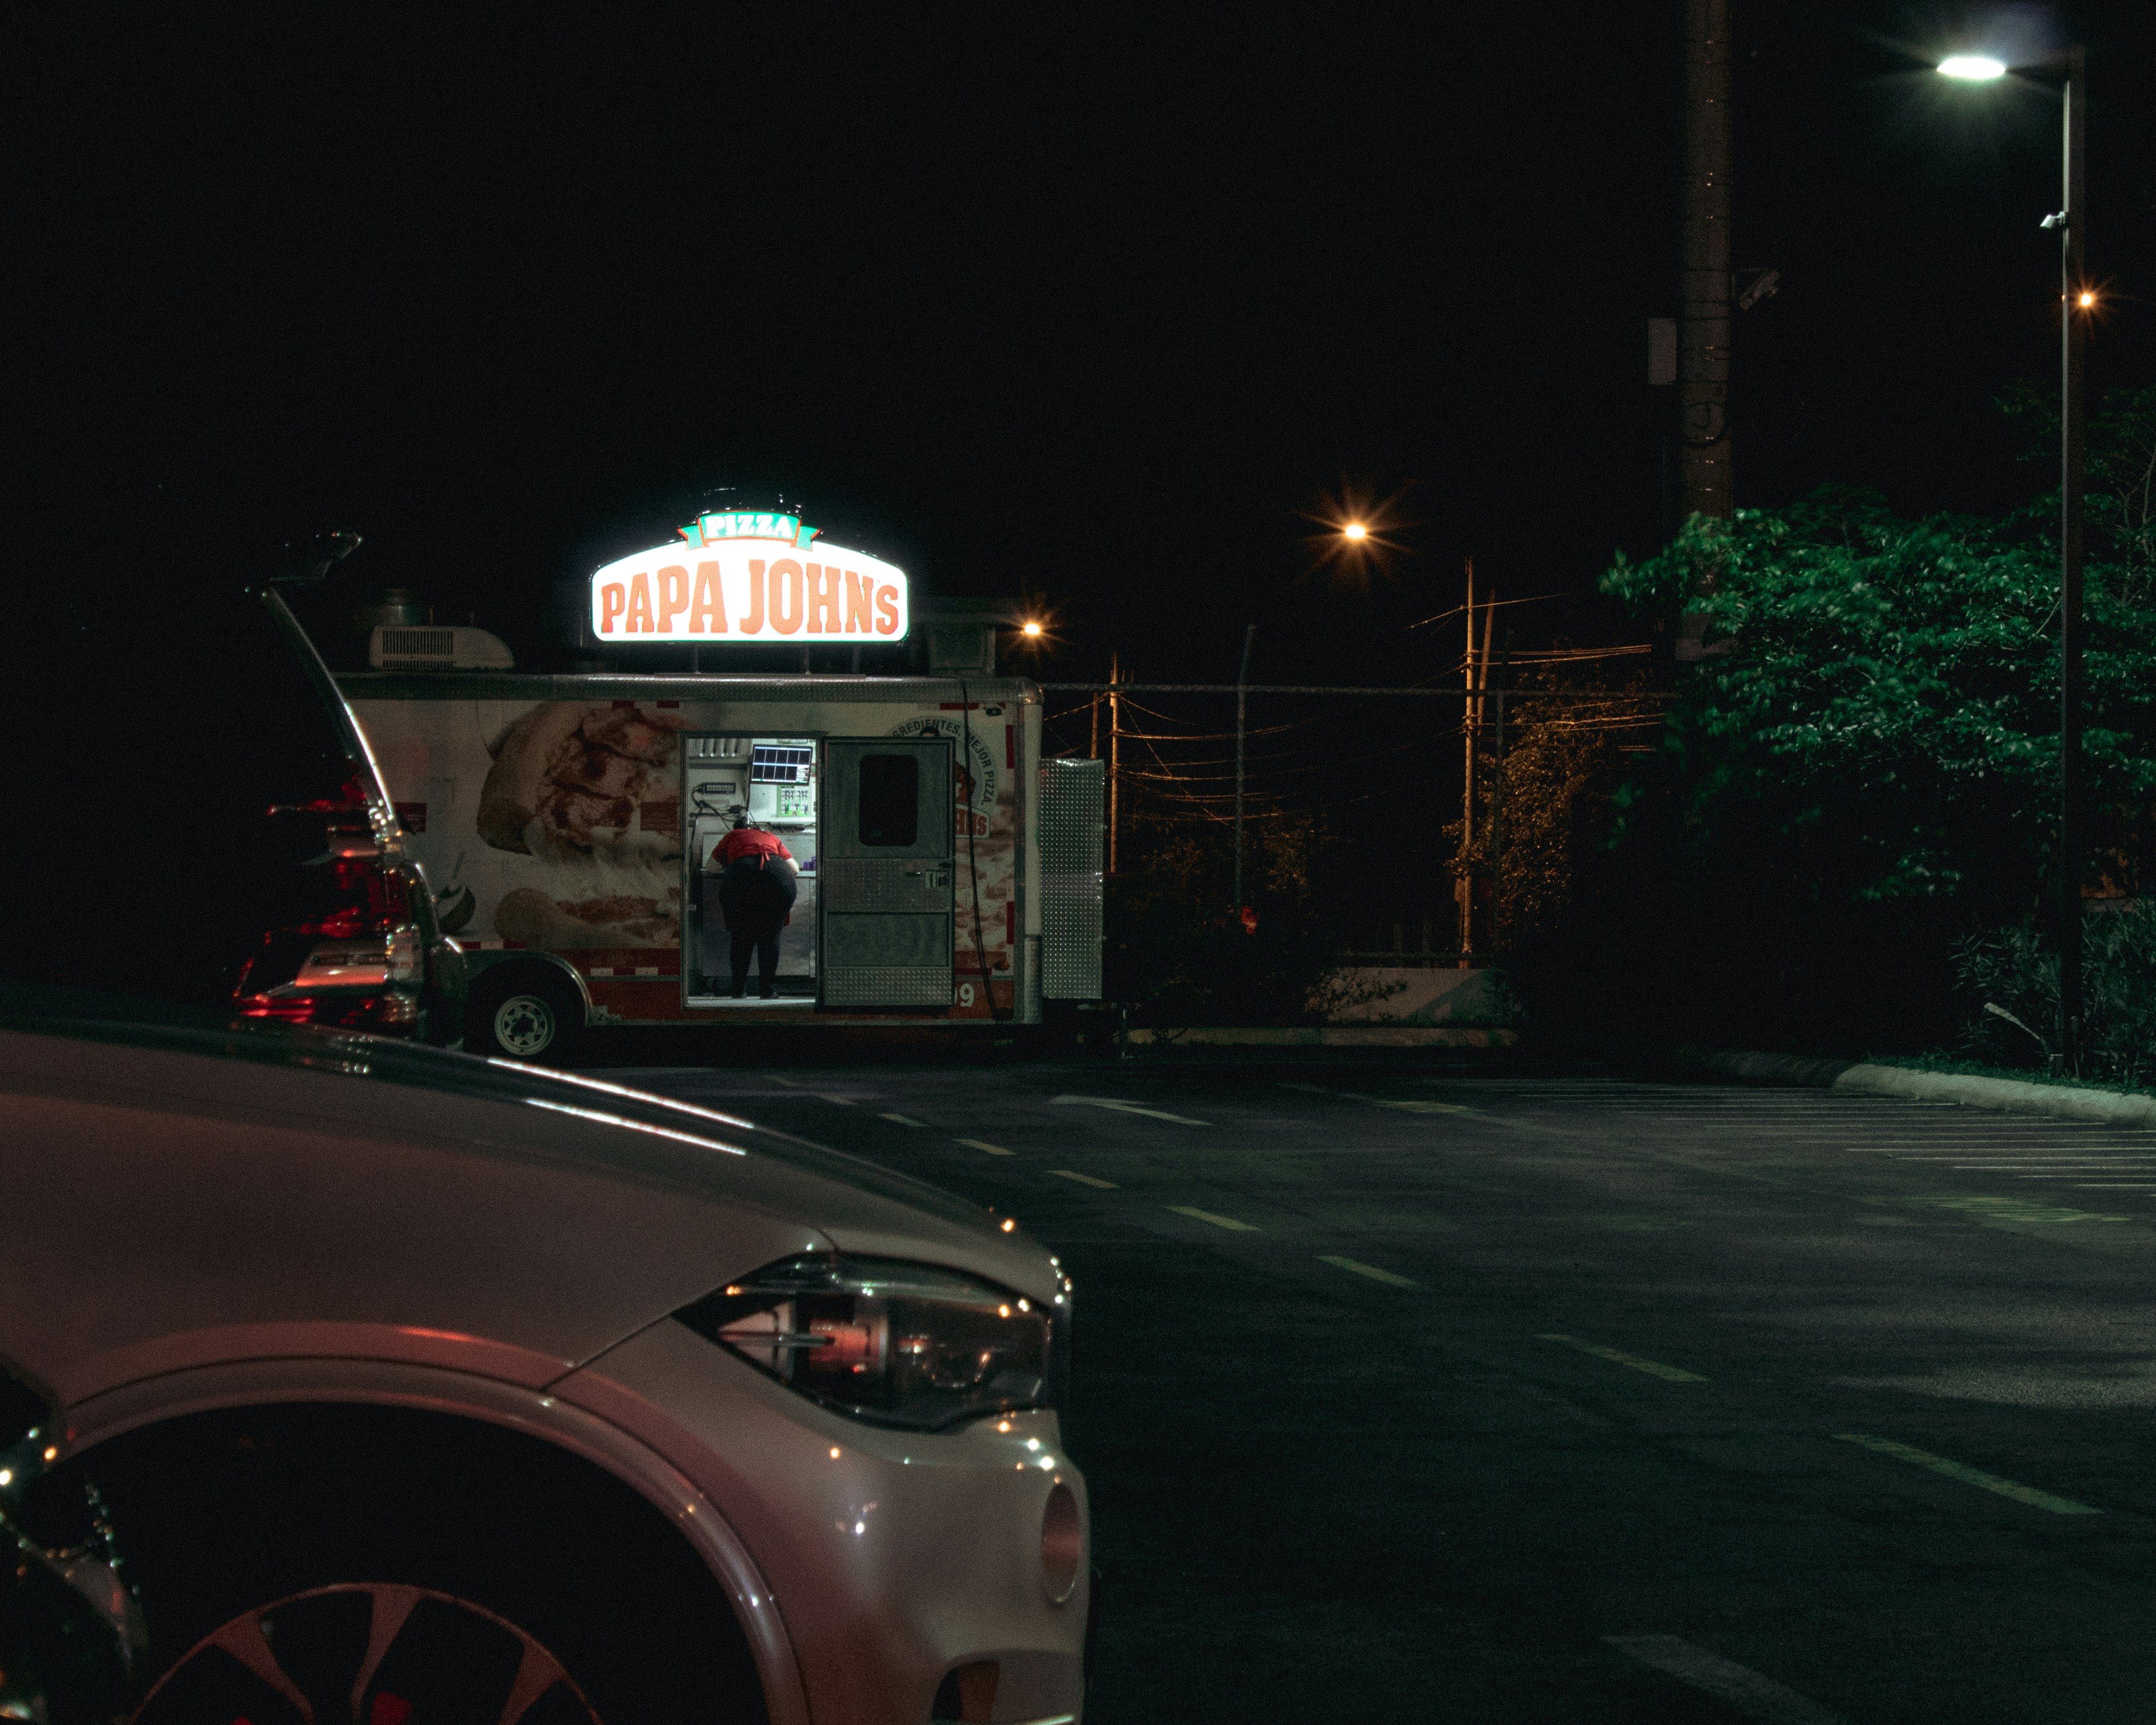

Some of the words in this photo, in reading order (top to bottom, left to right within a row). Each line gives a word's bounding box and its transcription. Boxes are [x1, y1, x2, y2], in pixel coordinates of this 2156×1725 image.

[705, 514, 792, 538] PIZZA
[600, 560, 728, 634] PAPA
[740, 558, 898, 635] JOHNS
[954, 983, 974, 1007] 9
